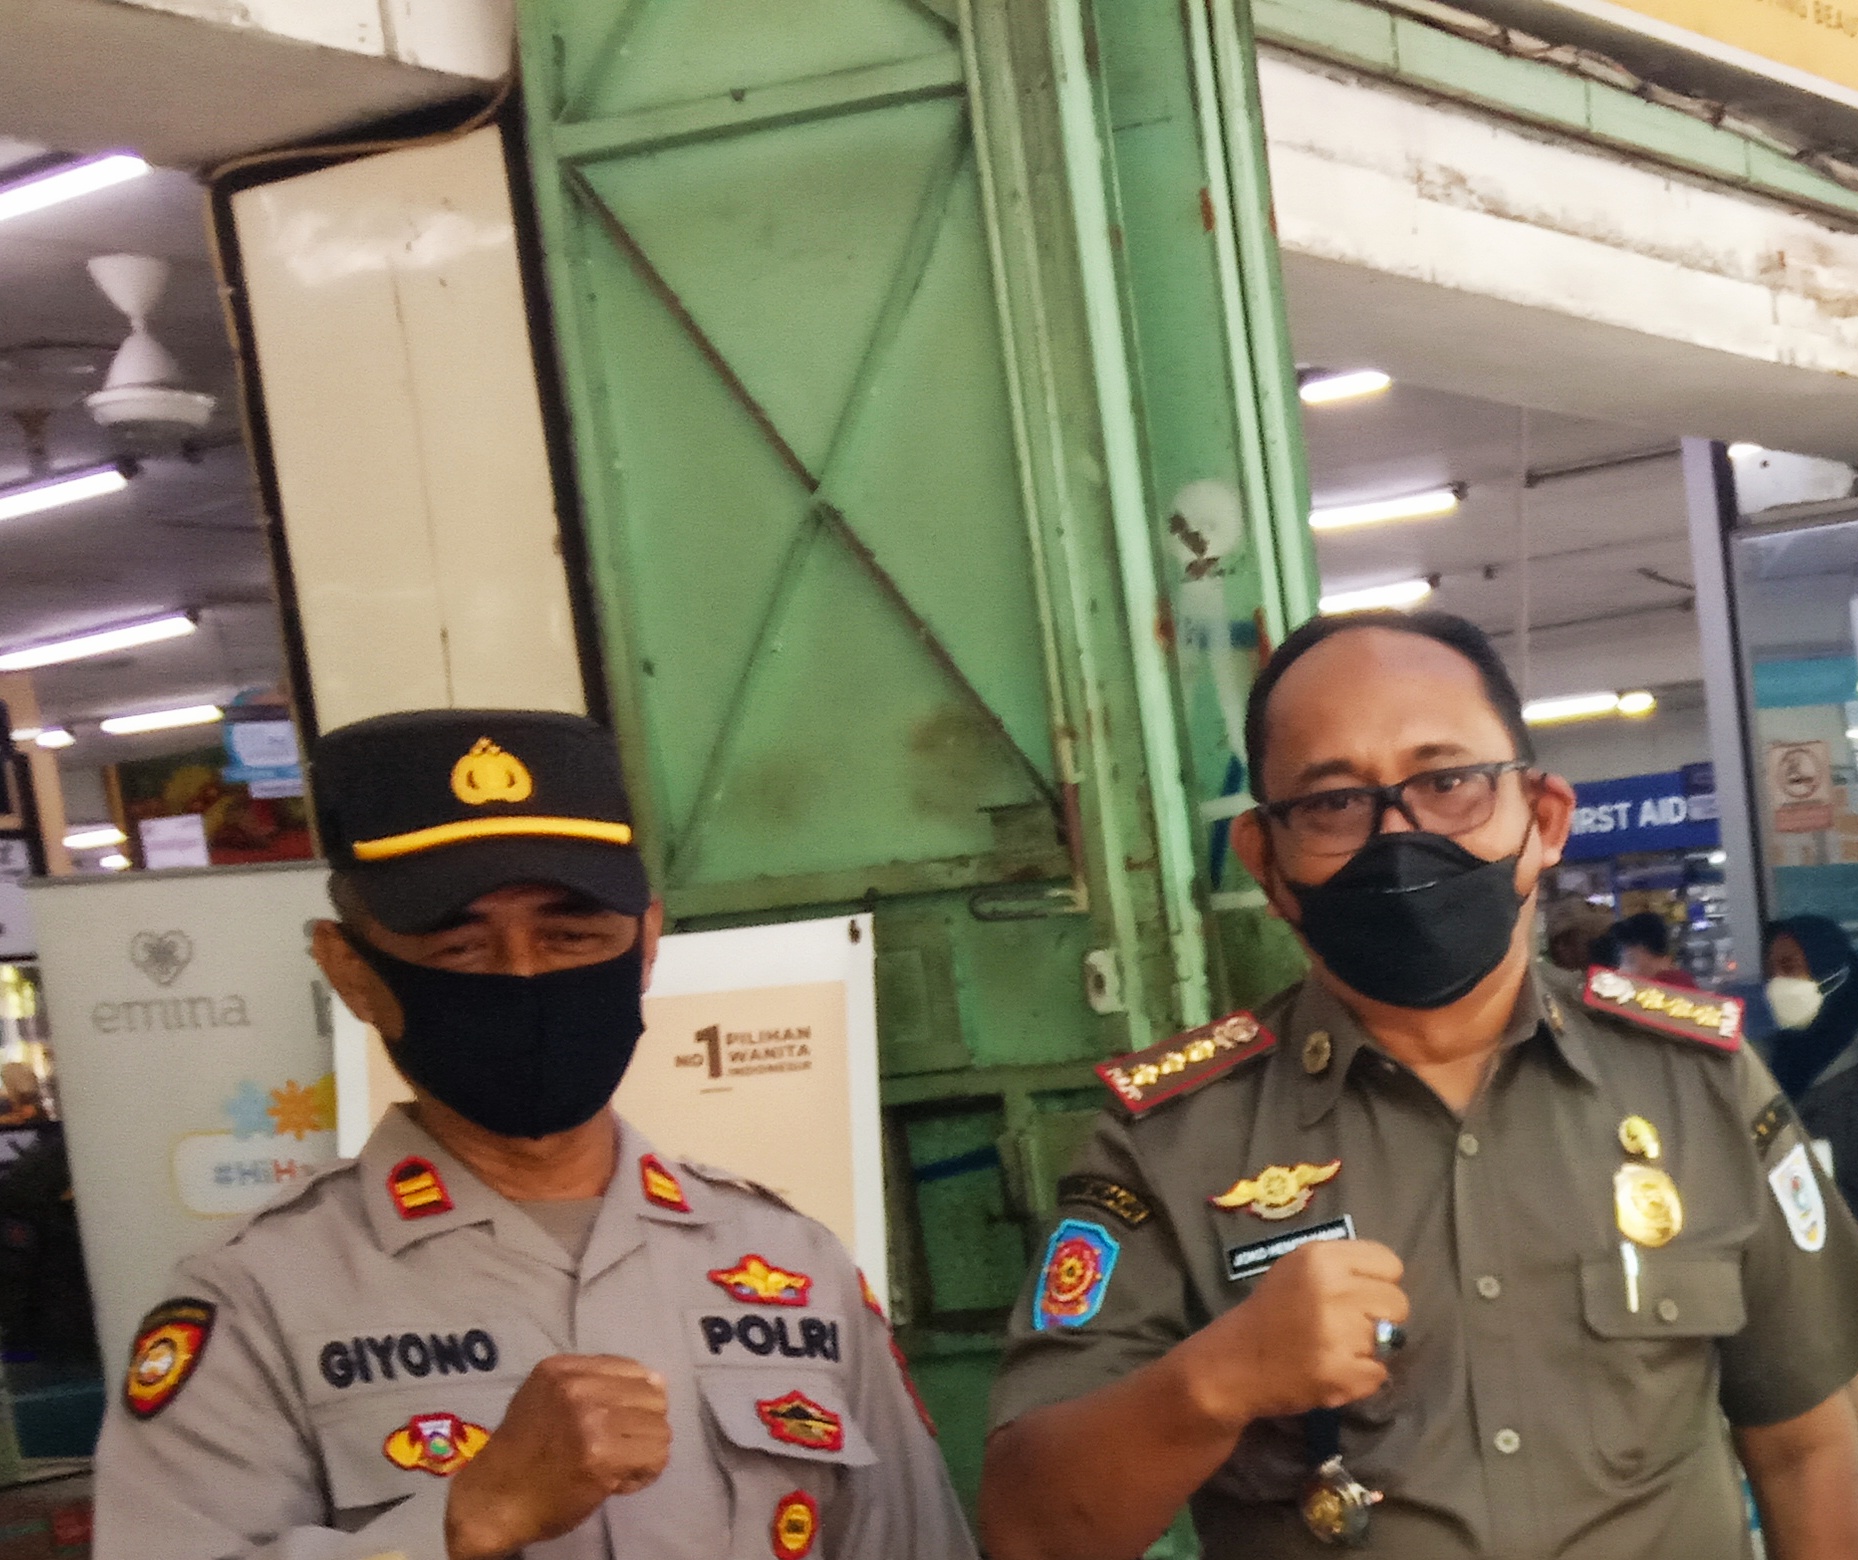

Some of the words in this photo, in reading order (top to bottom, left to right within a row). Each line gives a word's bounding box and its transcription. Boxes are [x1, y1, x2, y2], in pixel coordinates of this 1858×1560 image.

[1571, 800, 1633, 836] IRST
[1638, 795, 1688, 829] AID
[92, 994, 251, 1034] emina
[694, 1023, 722, 1079] 1
[728, 1044, 811, 1062] WANITA
[319, 1328, 499, 1389] GIYONO
[700, 1314, 841, 1363] POLRI
